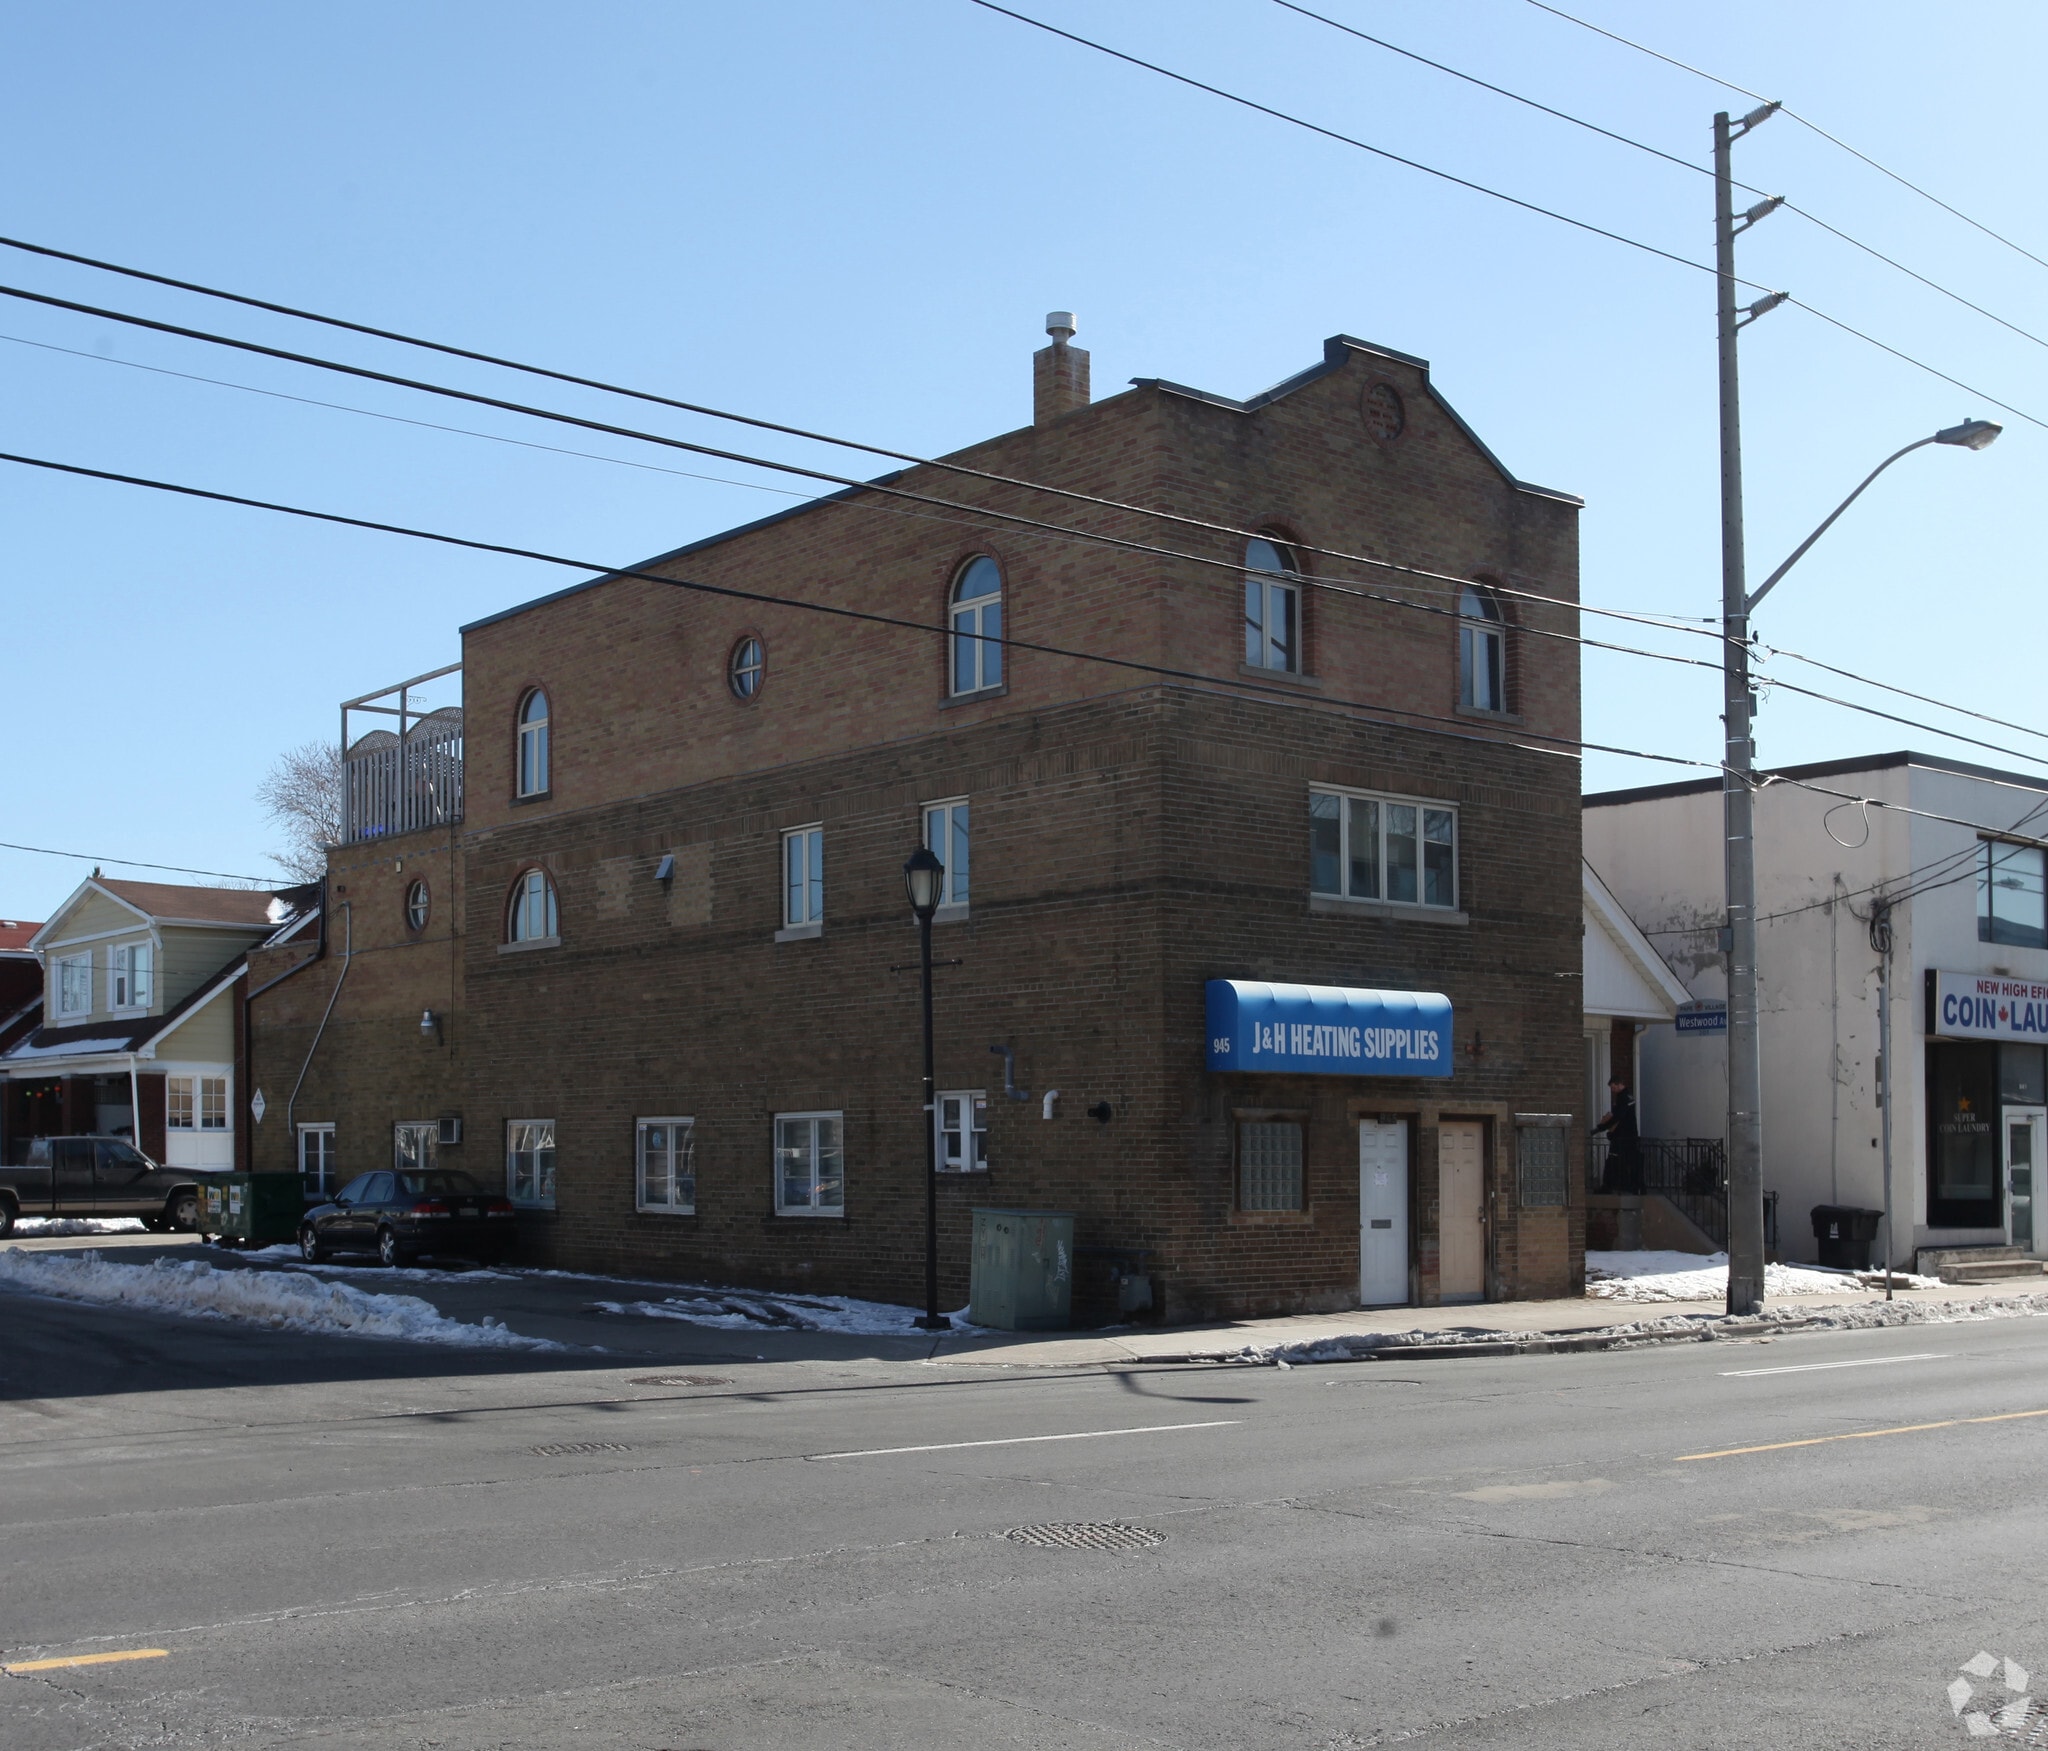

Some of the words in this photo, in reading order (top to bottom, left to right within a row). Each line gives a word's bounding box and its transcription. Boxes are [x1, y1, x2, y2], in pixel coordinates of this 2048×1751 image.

[1976, 980, 2000, 996] NEW
[2002, 982, 2028, 998] HIGH
[1679, 1015, 1718, 1028] Westwood
[1943, 993, 1996, 1030] COIN
[2010, 1000, 2048, 1034] LAU
[1213, 1037, 1230, 1054] 945
[1290, 1023, 1361, 1058] HEATING
[1364, 1027, 1439, 1061] SUPPLIES
[1957, 1122, 1990, 1133] LAUNDRY
